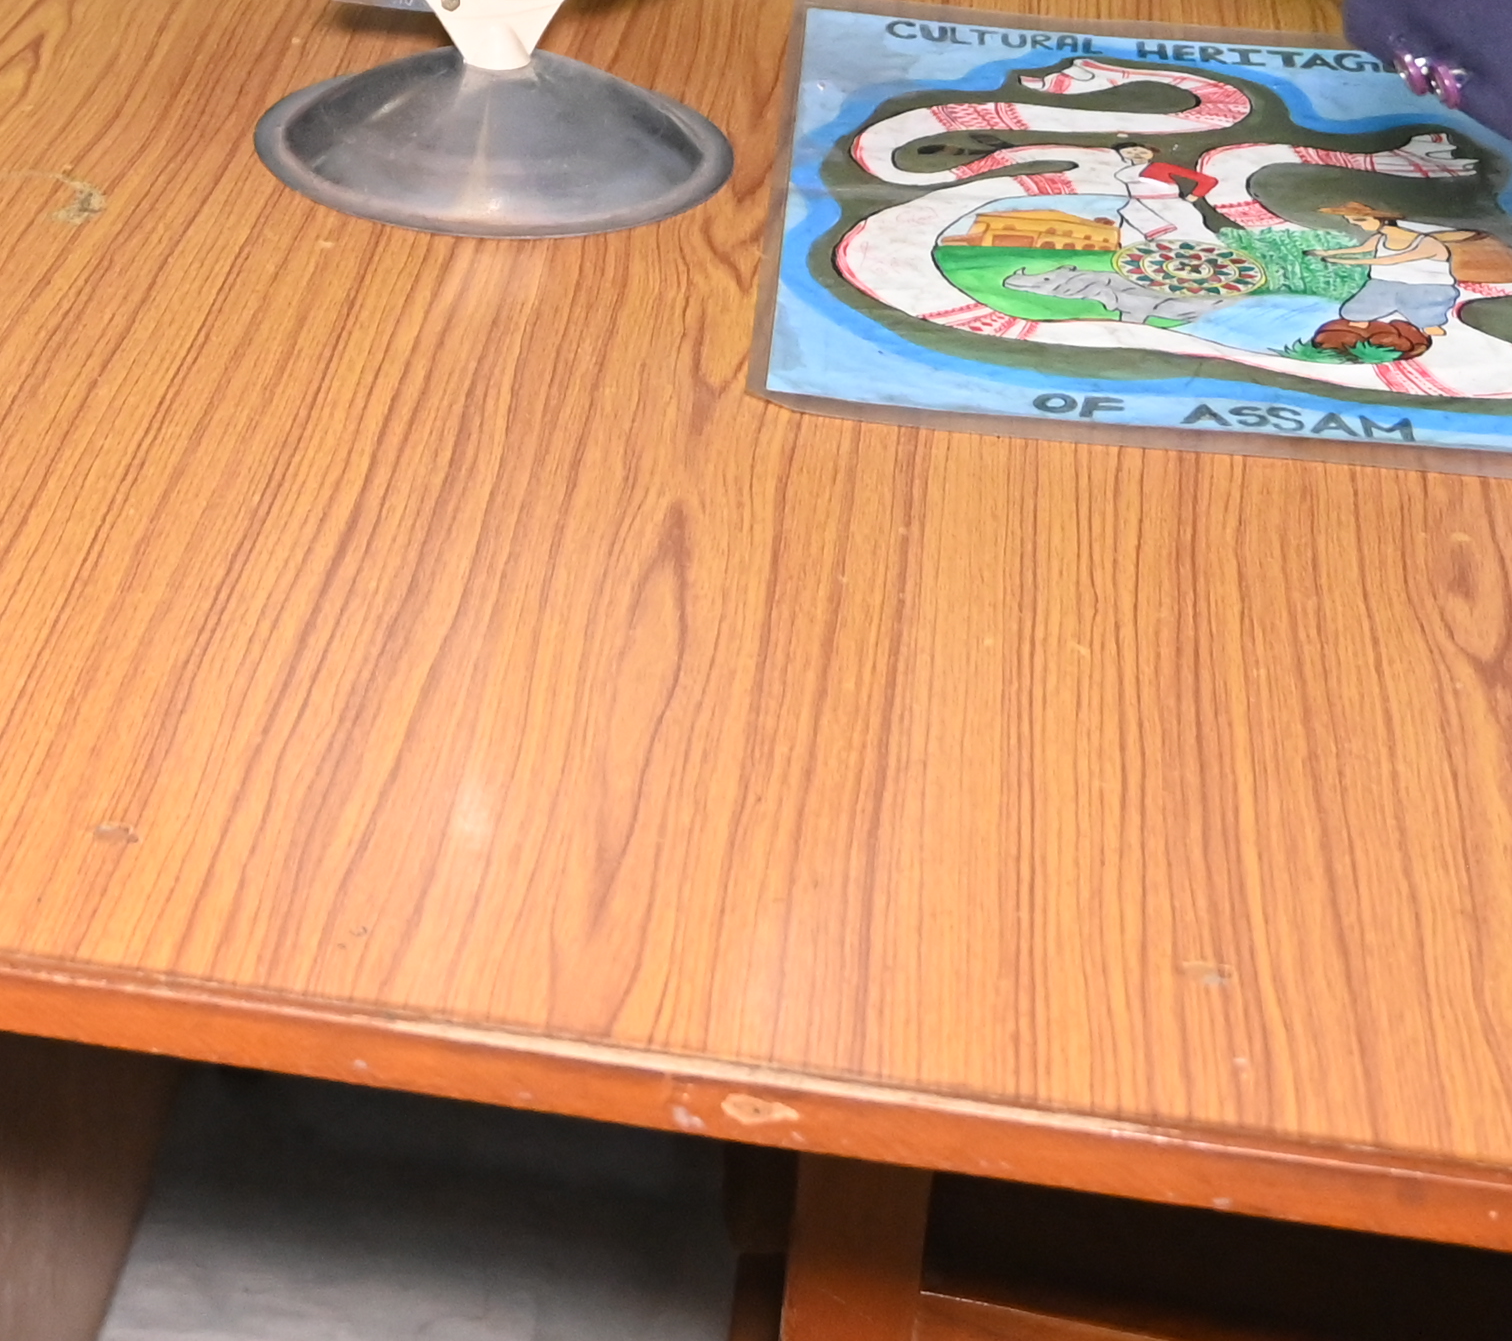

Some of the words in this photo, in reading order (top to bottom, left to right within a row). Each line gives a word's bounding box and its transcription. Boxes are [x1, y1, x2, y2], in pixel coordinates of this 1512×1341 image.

[885, 19, 1104, 56] CULTURAL
[1032, 393, 1125, 418] OF
[1180, 404, 1416, 442] ASSAM
